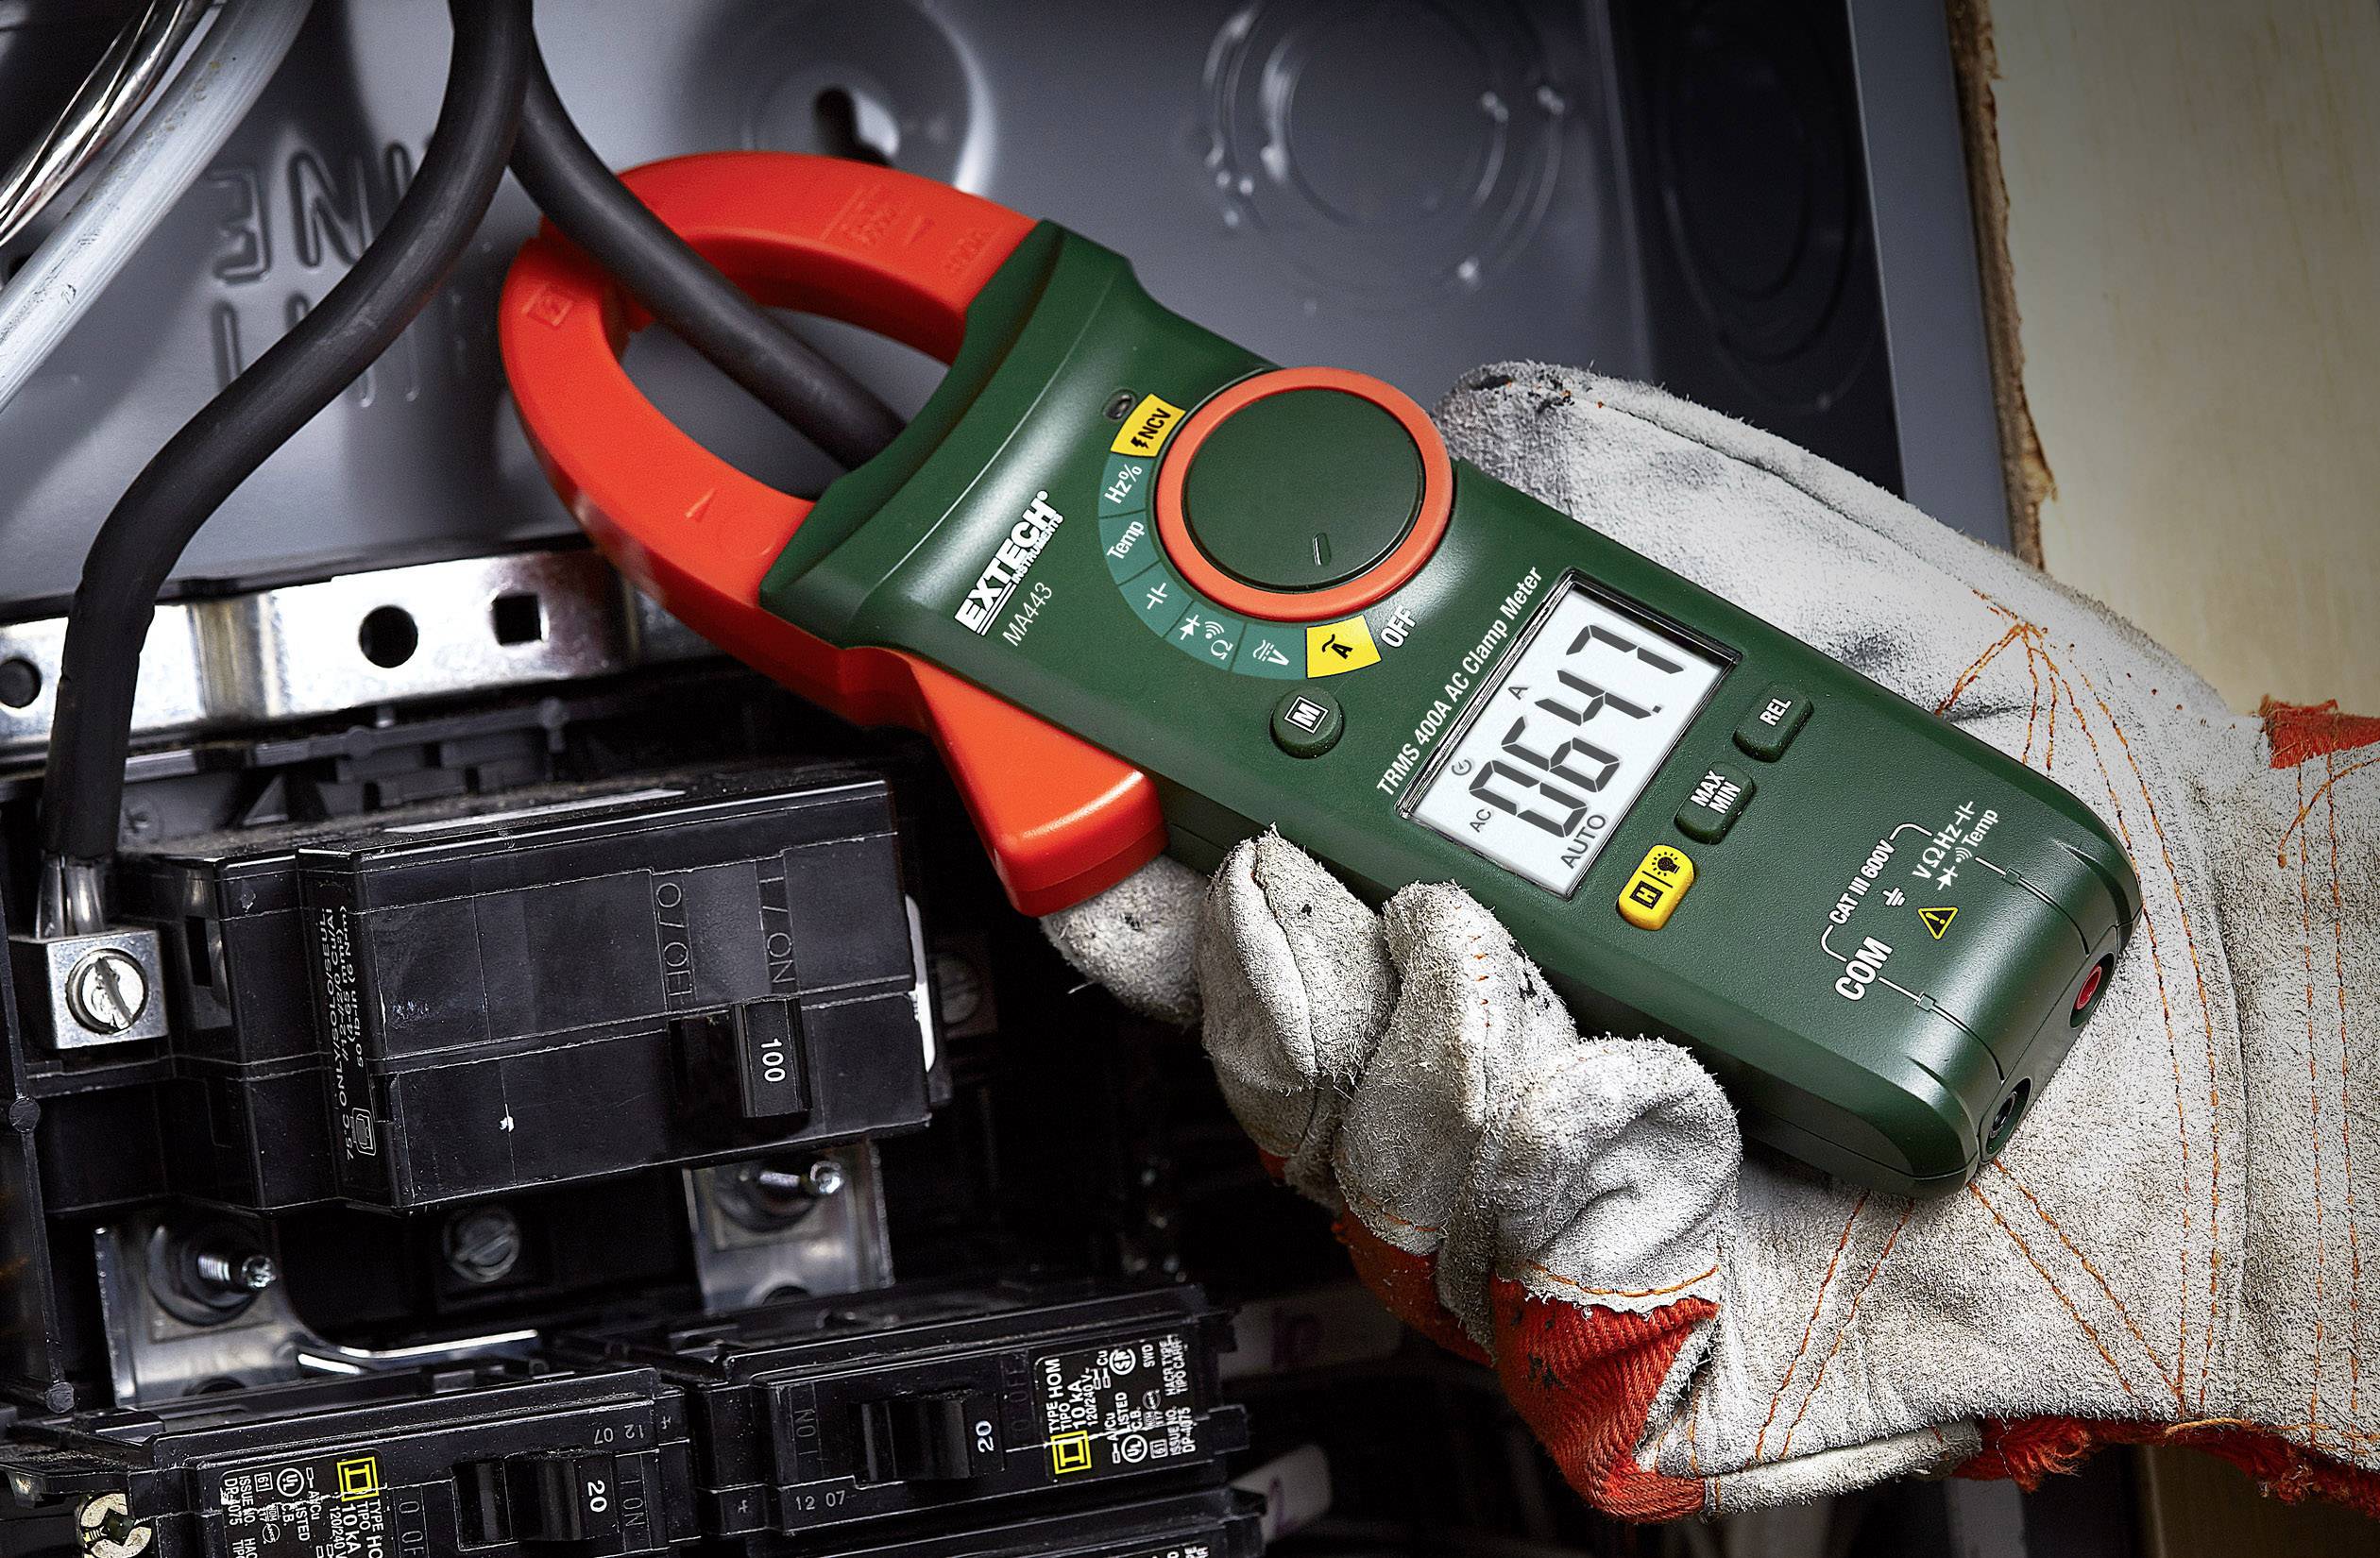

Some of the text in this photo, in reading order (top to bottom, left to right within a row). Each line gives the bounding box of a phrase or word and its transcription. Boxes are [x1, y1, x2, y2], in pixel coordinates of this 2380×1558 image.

[1138, 407, 1171, 440] NCV
[1011, 513, 1063, 584] INSTRUMENTS
[1107, 520, 1145, 559] Temp
[1002, 582, 1052, 647] MA443
[1380, 604, 1417, 649] OFF
[1376, 567, 1542, 797] TRMS 400A AC Clamp Meter
[1507, 685, 1529, 701] A
[1292, 703, 1321, 727] M
[1759, 697, 1793, 727] REL
[1690, 770, 1726, 807] MAX
[1708, 781, 1742, 814] MIN
[1469, 807, 1492, 833] AC
[1961, 809, 1999, 848] Temp
[1560, 814, 1606, 870] AUTO
[1636, 886, 1658, 905] H
[1828, 838, 1896, 925] CAT III 600V
[1834, 936, 1894, 1001] COM
[355, 1042, 364, 1068] 50
[760, 1038, 786, 1083] 100
[1096, 1350, 1109, 1366] Cu
[1045, 1358, 1064, 1433] TYPE HOM
[1066, 1380, 1087, 1430] 10 kA
[1081, 1383, 1098, 1427] 120/240
[1058, 1402, 1073, 1431] TIPO
[594, 1424, 644, 1445] 12 07
[975, 1420, 994, 1453] 20
[238, 1475, 254, 1507] ISSUE
[587, 1480, 607, 1513] 20
[795, 1490, 847, 1511] 12 07
[330, 1505, 346, 1550] 120/240
[341, 1503, 362, 1554] 10 kA
[356, 1500, 371, 1530] TIPO
[369, 1499, 384, 1533] TYPE
